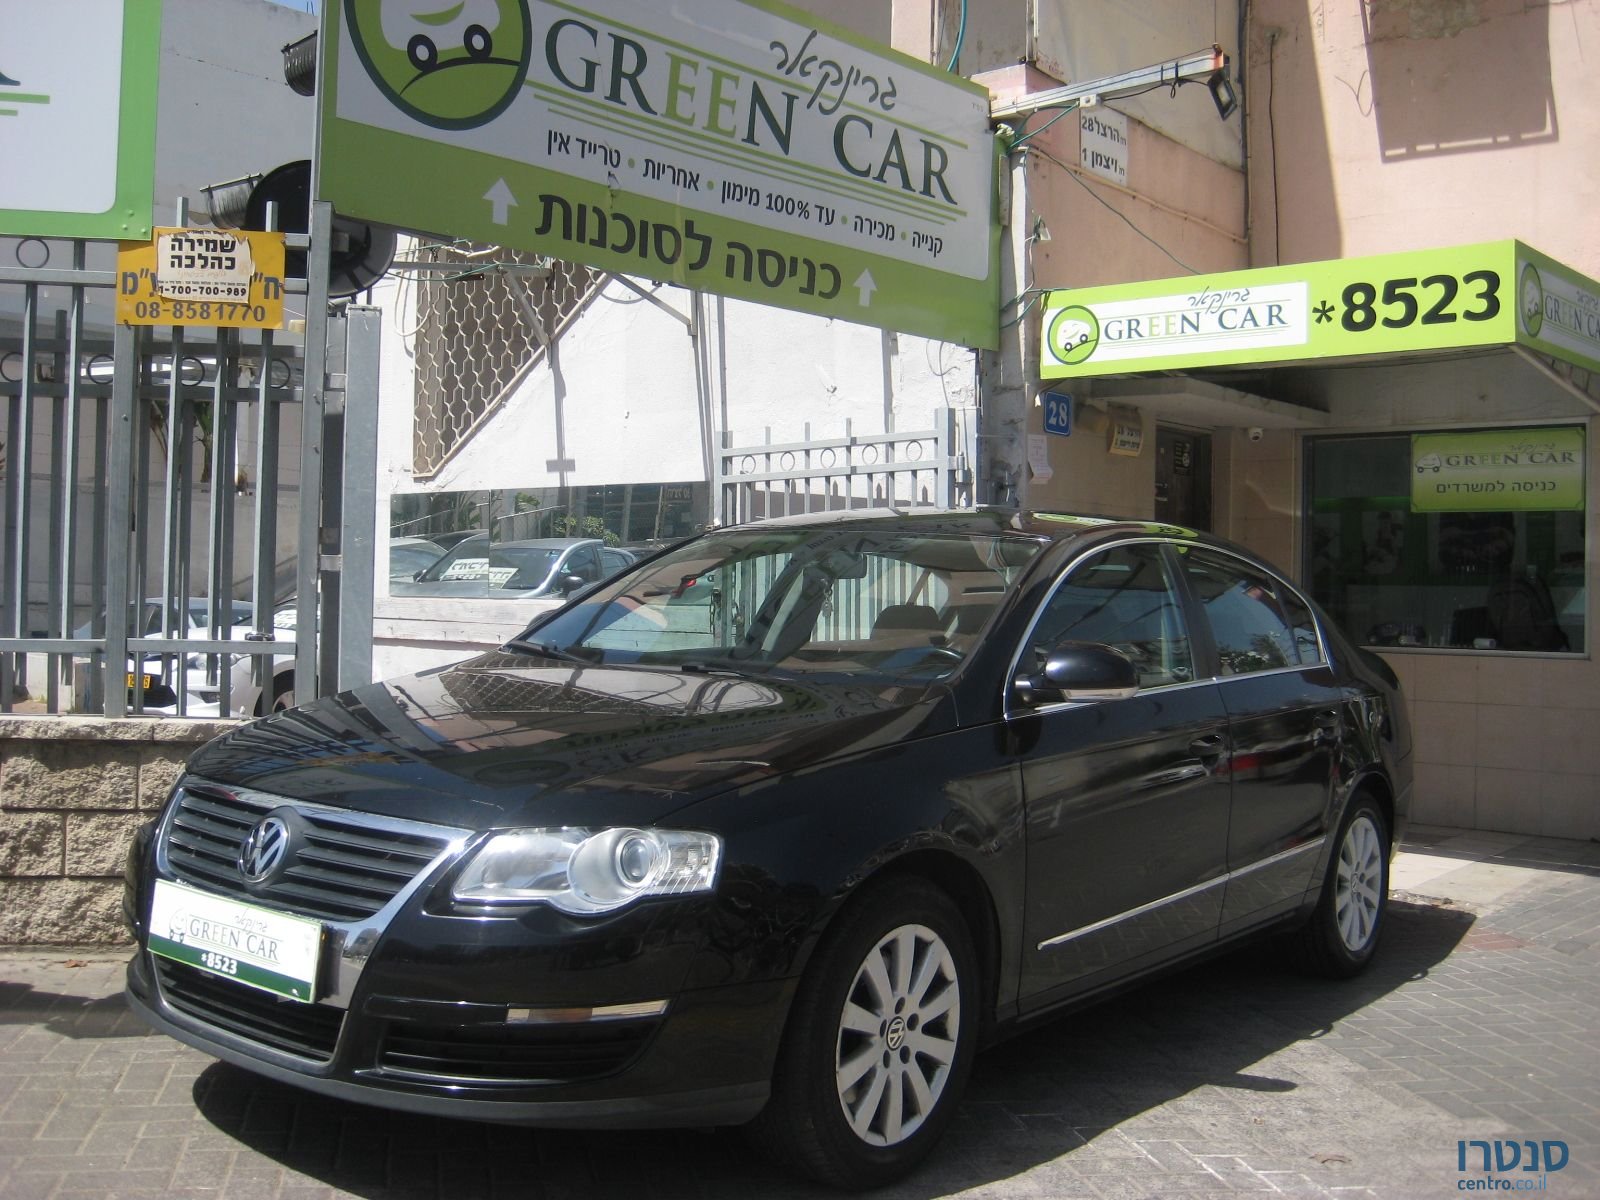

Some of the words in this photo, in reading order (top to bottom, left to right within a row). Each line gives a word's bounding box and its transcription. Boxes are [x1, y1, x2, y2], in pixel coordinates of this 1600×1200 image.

[769, 29, 897, 116] גרינקאר
[545, 18, 799, 156] GREEN
[833, 114, 958, 206] CAR
[547, 129, 571, 156] אין
[575, 137, 621, 169] טרייד
[1082, 147, 1087, 161] 1
[642, 158, 700, 192] אחריות
[1091, 151, 1118, 173] ויצמן
[721, 180, 760, 206] מימון
[765, 192, 810, 220] 100%
[814, 204, 836, 226] עד
[853, 215, 895, 241] מכירה
[170, 237, 236, 253] שמירה
[534, 194, 713, 271] לסוכנות
[912, 231, 943, 258] קנייה
[170, 252, 236, 270] כהלכה
[725, 241, 842, 300] כניסה
[158, 285, 247, 296] 1-700-700-989
[135, 301, 266, 322] 08-8581770
[1104, 311, 1201, 342] GREEN
[1217, 303, 1288, 331] CAR
[1048, 401, 1068, 427] 28
[1446, 453, 1519, 466] GREEN
[1529, 451, 1576, 465] CAR
[1436, 480, 1505, 494] למשרדים
[1511, 480, 1557, 492] כניסה
[189, 918, 241, 949] GREEN
[246, 934, 279, 961] CAR
